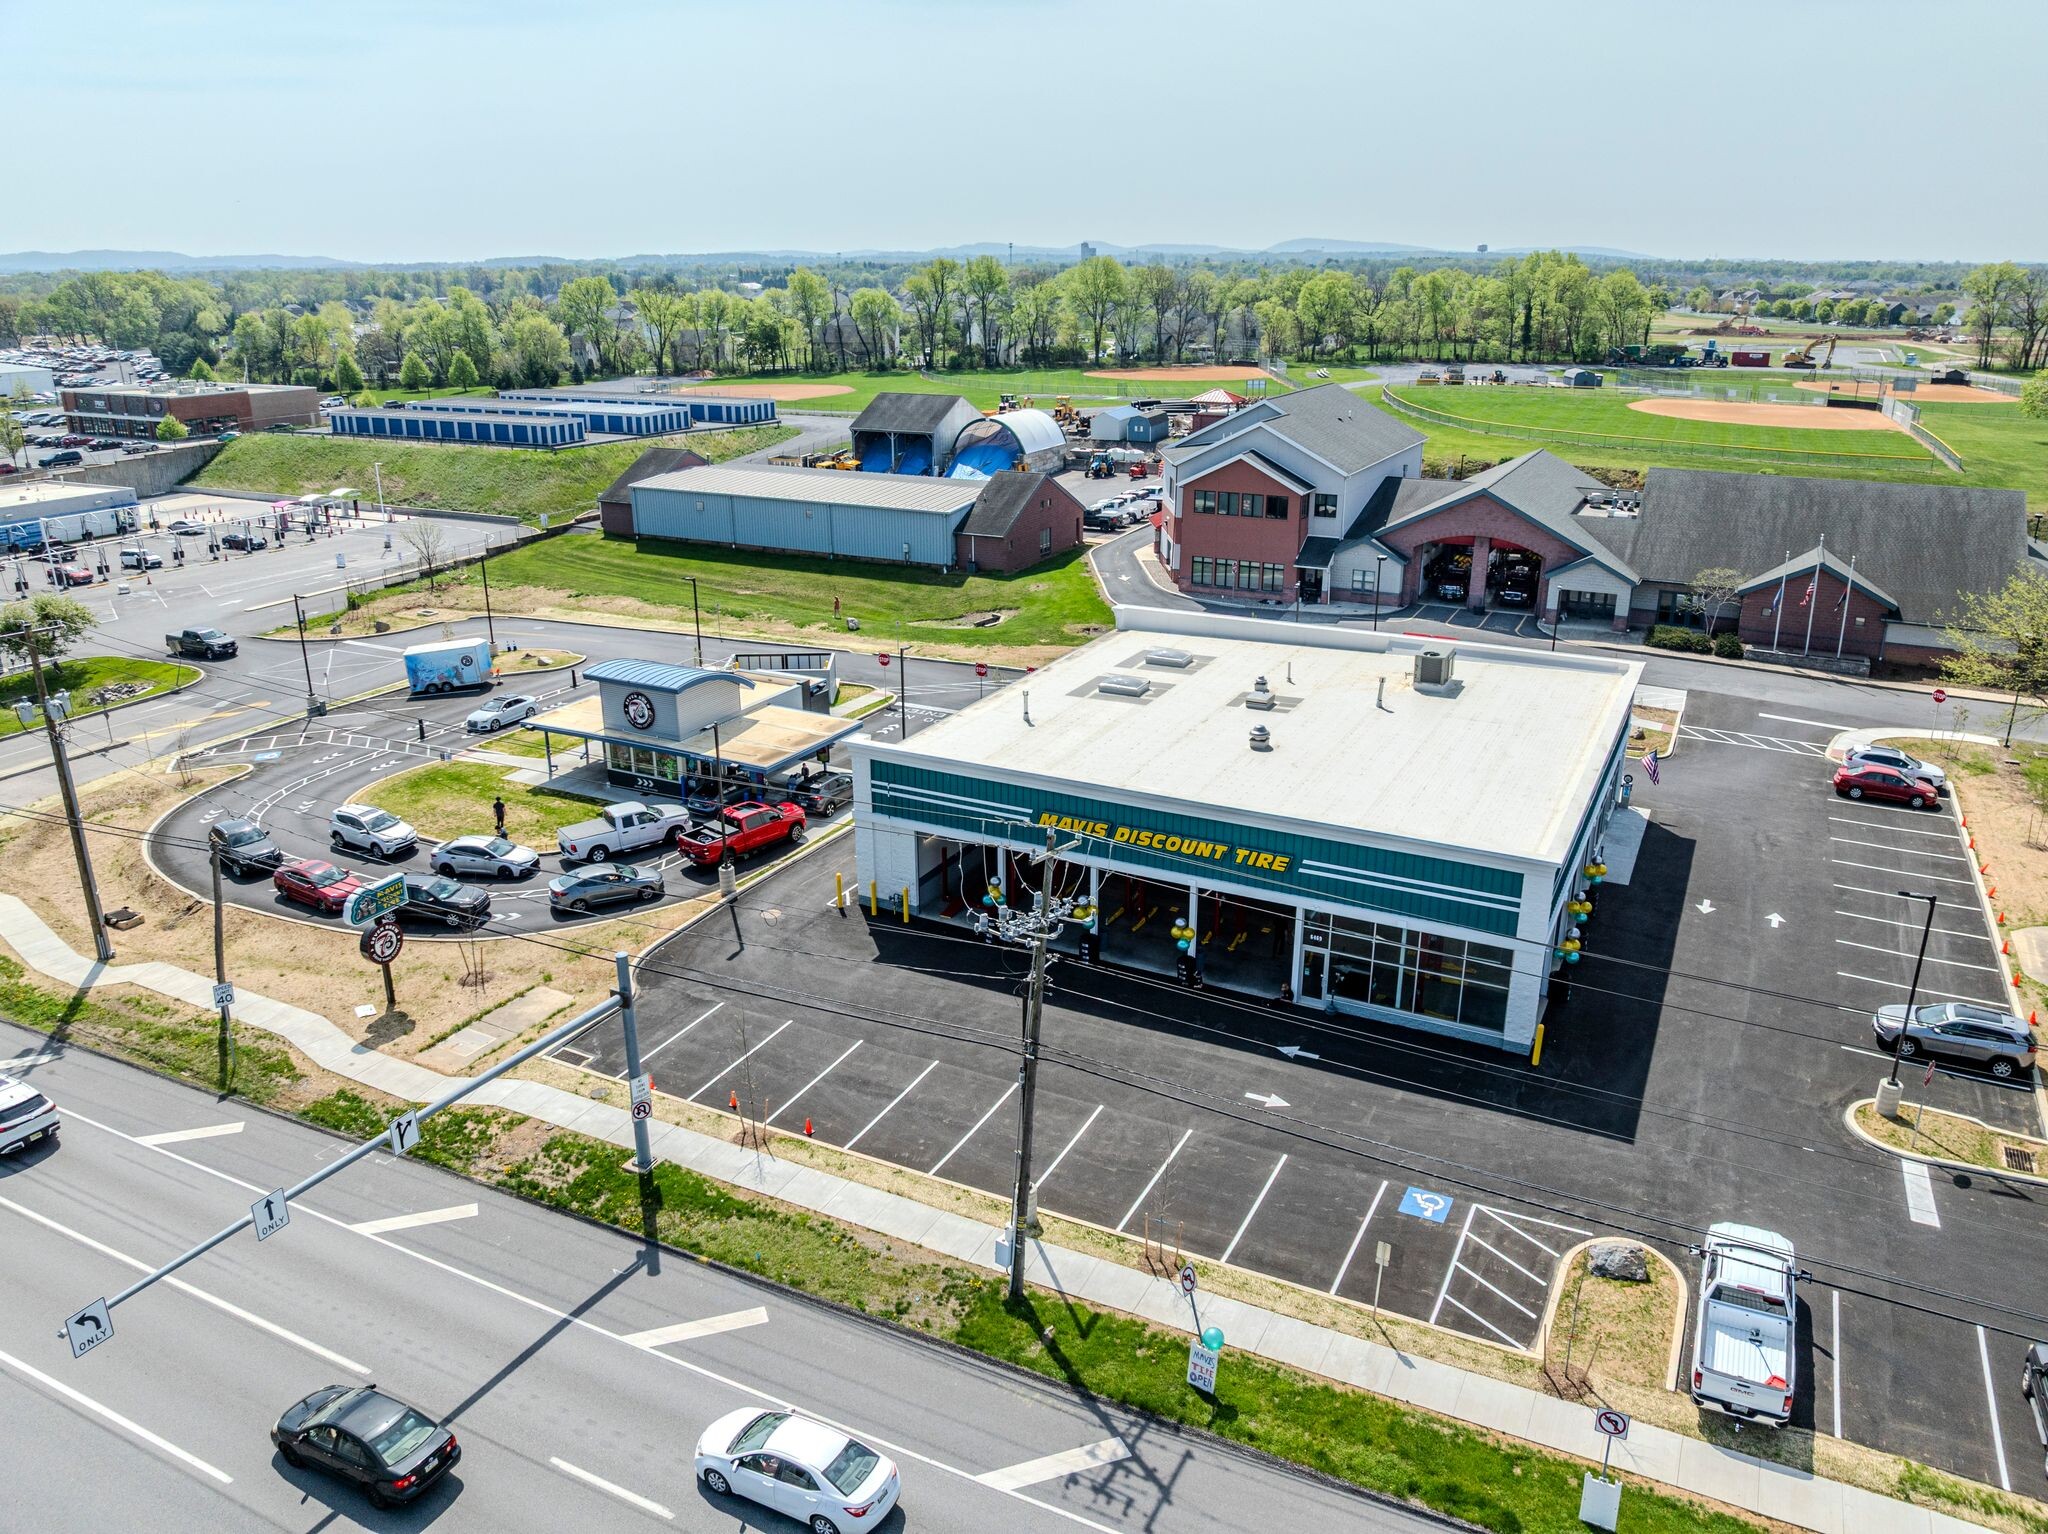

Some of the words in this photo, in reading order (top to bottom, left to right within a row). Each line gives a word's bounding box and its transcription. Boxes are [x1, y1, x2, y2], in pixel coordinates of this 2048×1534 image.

[1933, 692, 1946, 700] STOP
[1039, 813, 1108, 838] MAVIS
[1114, 827, 1229, 860] DISCOUNT
[1235, 848, 1290, 872] TIRE
[376, 881, 403, 899] MAVIS
[370, 926, 385, 945] SEVEN
[385, 924, 399, 933] BREW
[215, 984, 231, 992] SPEED
[216, 993, 233, 1004] 40
[262, 1216, 285, 1235] ONLY
[79, 1327, 107, 1351] ONLY
[1193, 1351, 1216, 1369] MAVIS
[1191, 1361, 1215, 1379] TIRE
[1189, 1371, 1213, 1388] OPEN
[1730, 1387, 1755, 1397] GMC
